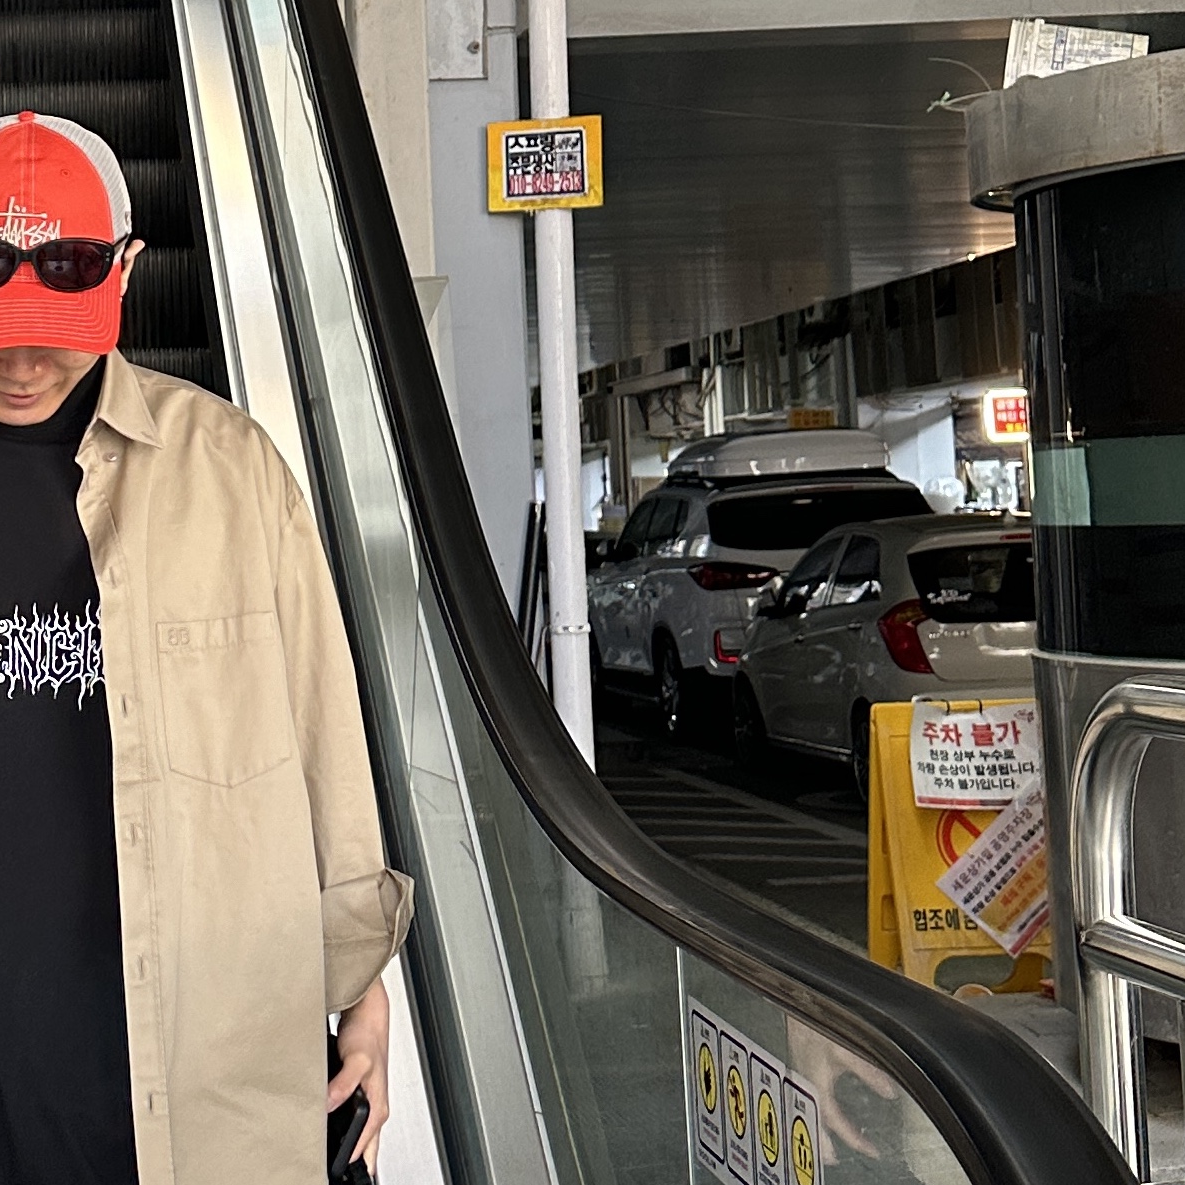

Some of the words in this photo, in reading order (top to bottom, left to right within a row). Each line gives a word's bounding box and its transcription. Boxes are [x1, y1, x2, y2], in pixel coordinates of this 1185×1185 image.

[922, 721, 962, 746] 주차
[971, 720, 1021, 746] 불가
[979, 749, 1015, 760] 누수로
[917, 761, 935, 774] 차량
[939, 764, 970, 776] 손상이
[934, 777, 954, 789] 주차
[958, 777, 1020, 790] 불가입니다.
[913, 908, 960, 931] 협조에
